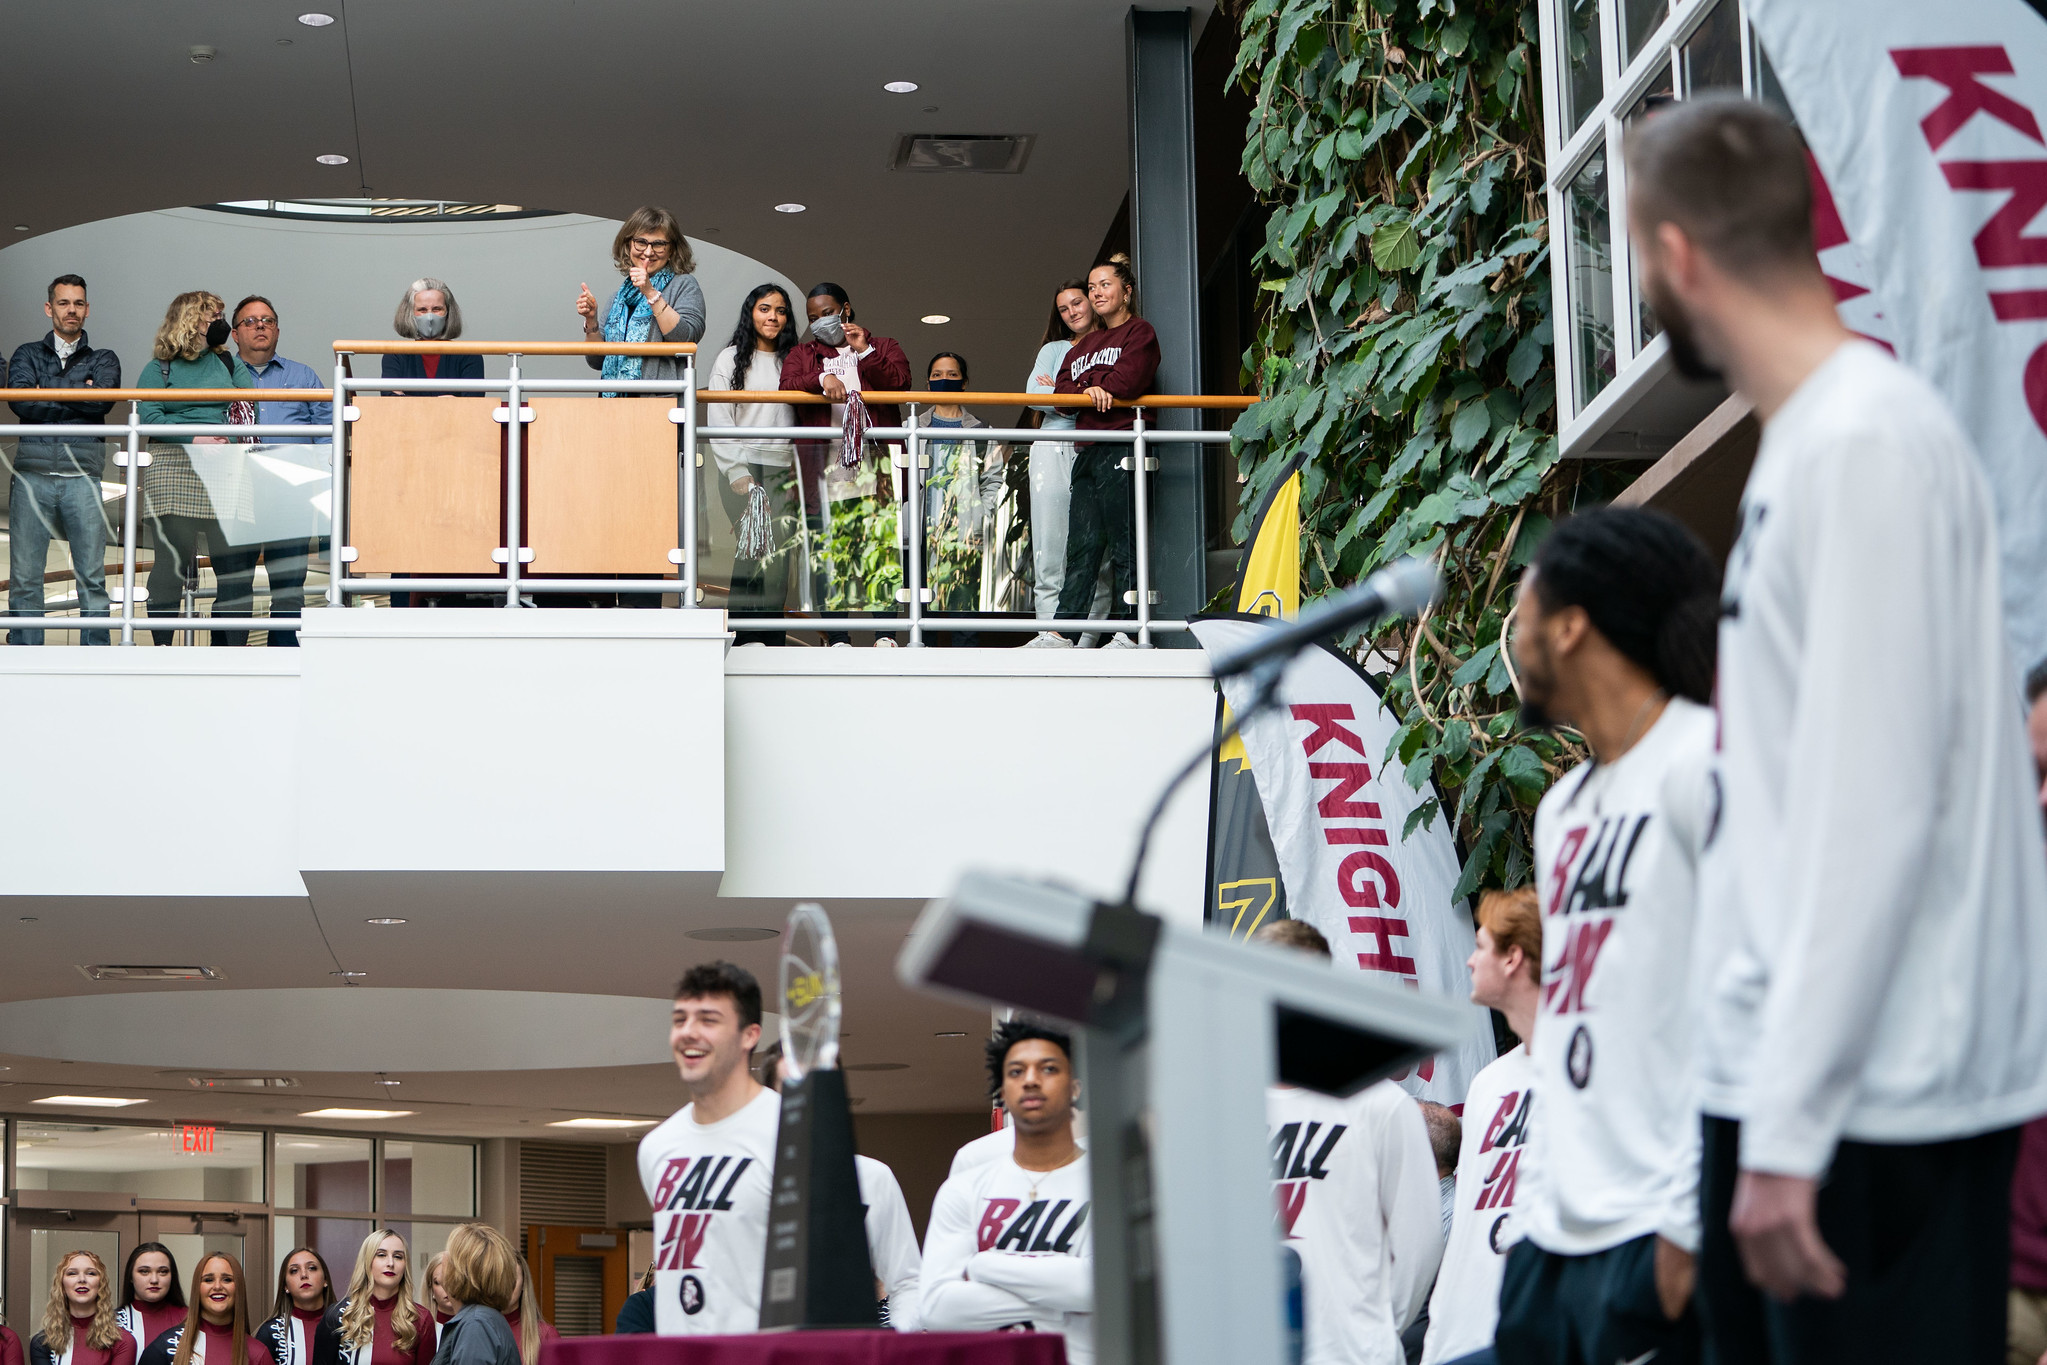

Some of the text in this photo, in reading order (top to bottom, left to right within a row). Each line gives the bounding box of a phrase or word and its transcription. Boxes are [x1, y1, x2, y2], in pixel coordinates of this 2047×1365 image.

[183, 1126, 216, 1152] EXIT
[654, 1156, 754, 1212] BALL
[656, 1213, 713, 1271] IN
[978, 1198, 1091, 1252] BALL
